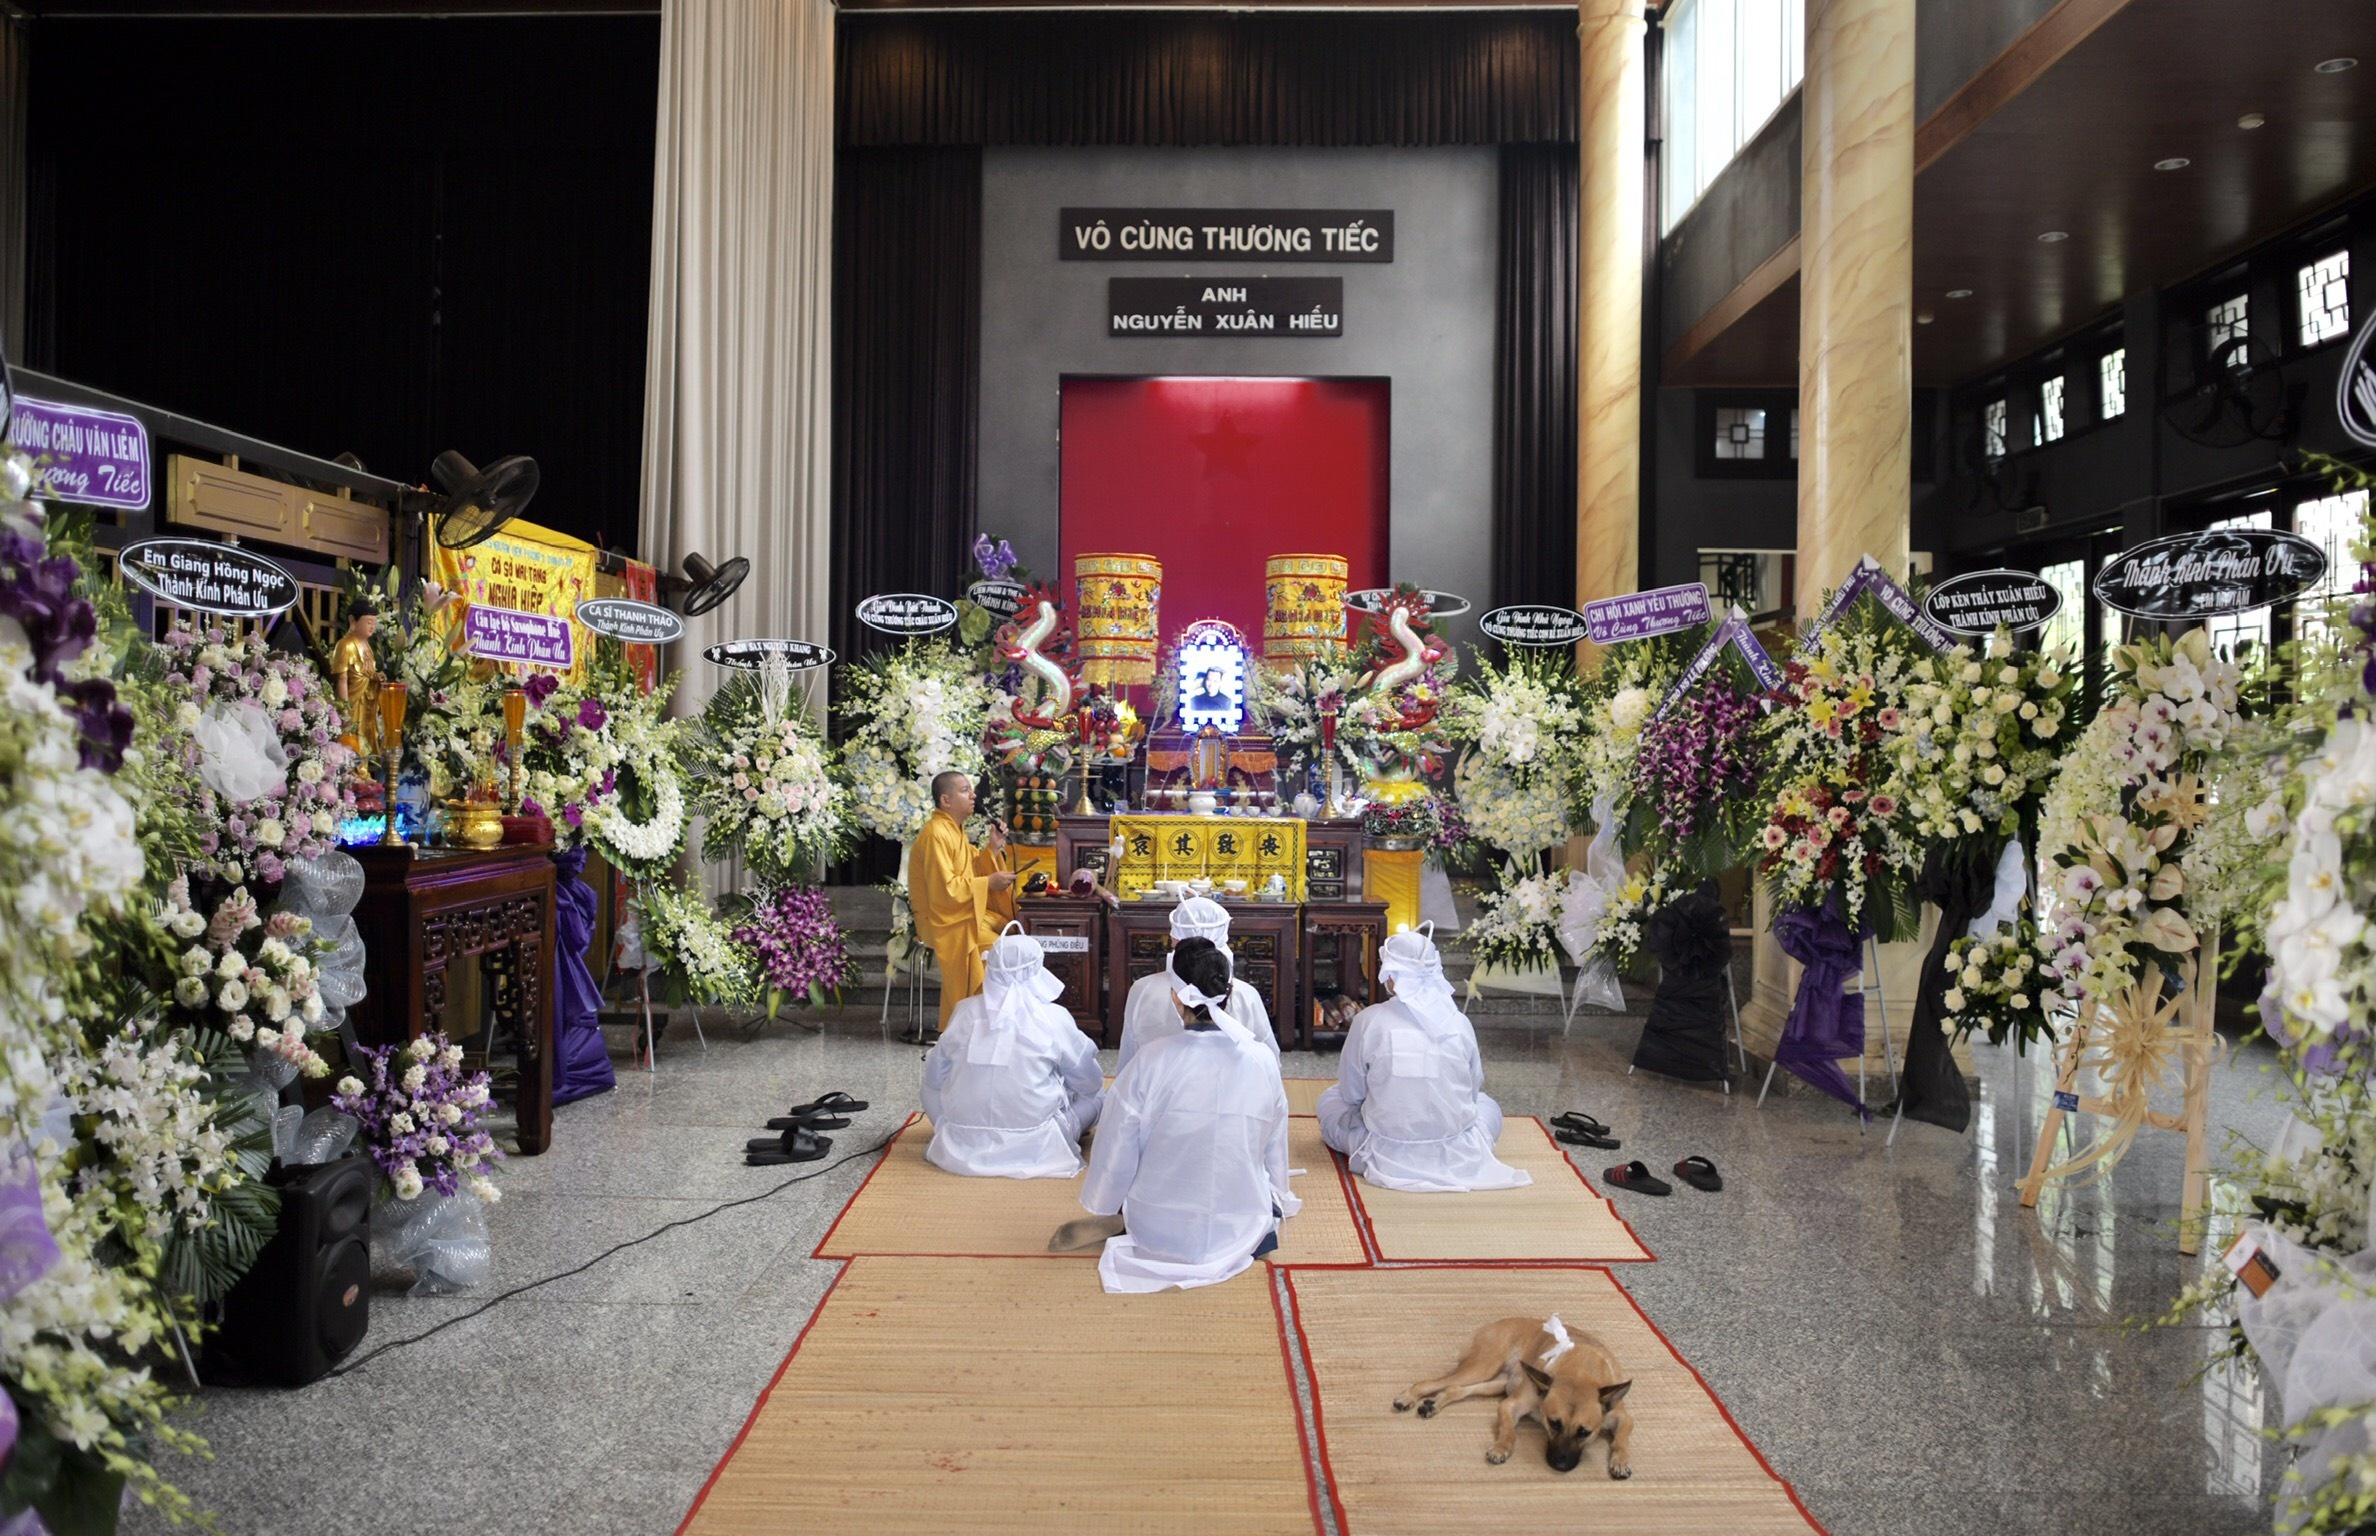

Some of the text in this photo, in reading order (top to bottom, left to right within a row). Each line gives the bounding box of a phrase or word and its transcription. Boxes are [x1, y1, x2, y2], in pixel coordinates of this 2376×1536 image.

[1075, 219, 1379, 252] VÔ CÙNG THƯƠNG TIẾC
[1201, 287, 1247, 302] ANH
[1113, 304, 1338, 330] NGUYỄN XUÂN HIẾU
[9, 411, 140, 462] RƯỜNG CHÂU VĂN LIÊM
[36, 465, 141, 495] ương Tiếc
[143, 548, 285, 590] Em Giang Hồng Ngọc
[2215, 549, 2261, 581] Phân
[157, 573, 268, 609] Thành Kính Phân Ưu
[1933, 580, 2046, 610] LỚP KÈN THẦY XUÂN HIẾU
[589, 605, 673, 627] CA SĨ THANH THẢO
[1589, 591, 1703, 623] CHI HỘI XANH YÊU THƯƠNG
[1949, 609, 1979, 628] THÀNH
[1979, 607, 2001, 626] KÍNH
[2001, 605, 2024, 623] PHÂN
[1593, 624, 1608, 639] Vô
[1611, 620, 1639, 637] Cùng
[1682, 608, 1707, 622] Tiếc
